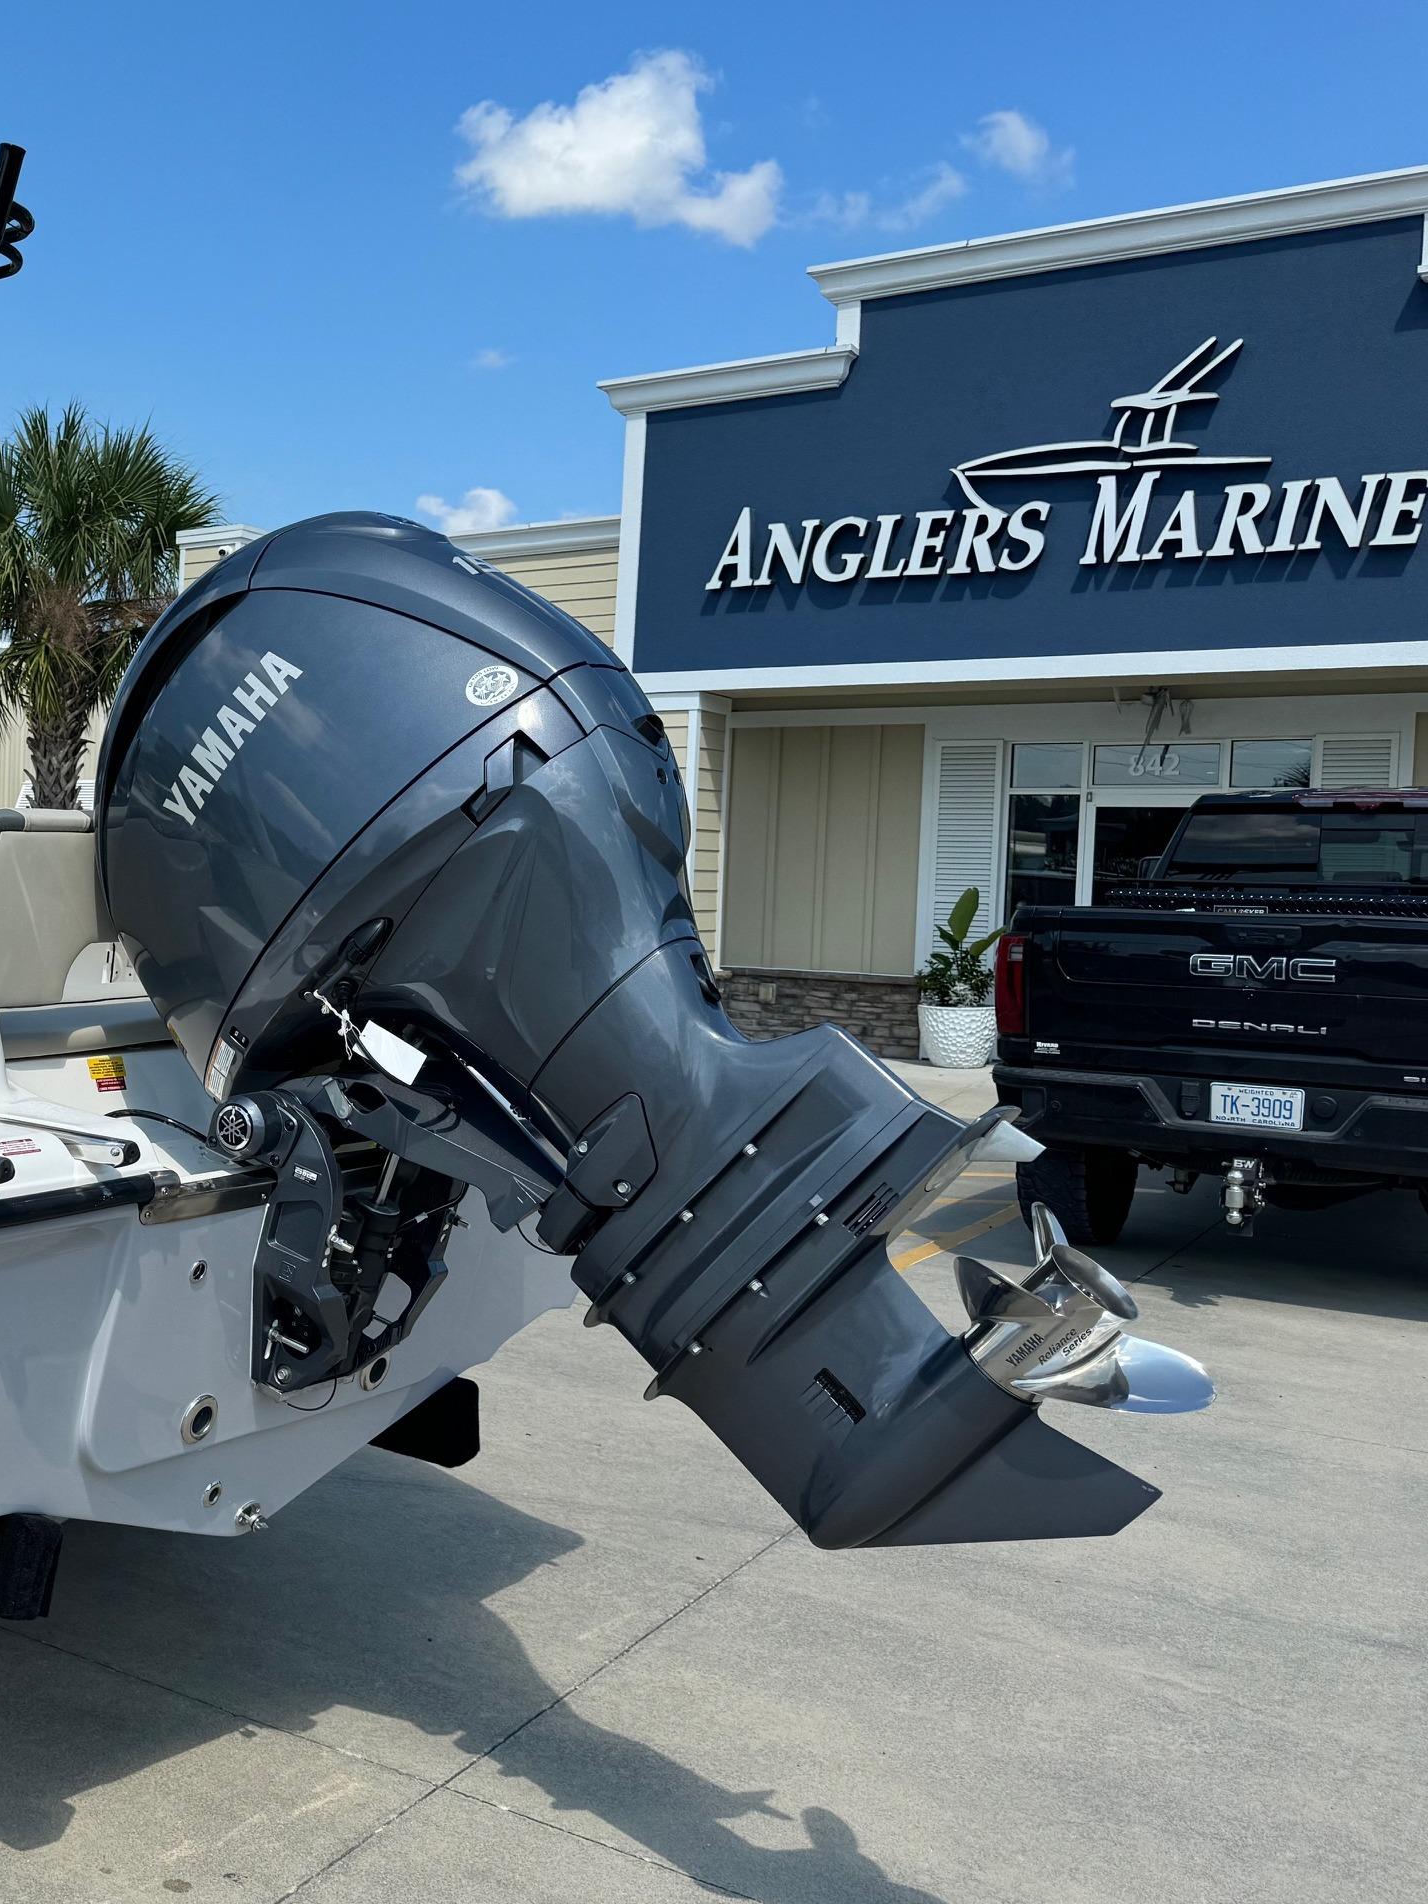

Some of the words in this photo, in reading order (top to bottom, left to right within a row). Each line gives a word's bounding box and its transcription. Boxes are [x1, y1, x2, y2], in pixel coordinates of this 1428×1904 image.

[705, 499, 1052, 590] ANGLERS
[1079, 471, 1428, 566] MARINE
[162, 650, 305, 826] YAMAHA
[1128, 753, 1181, 777] 842
[1189, 953, 1337, 983] GMC
[1192, 1018, 1327, 1035] DENALI
[1238, 1088, 1275, 1096] WEIGHTED
[1220, 1094, 1294, 1120] TK-3909
[1252, 1118, 1296, 1127] CAROLINA
[1005, 1333, 1045, 1367] YAMAHA
[1038, 1328, 1077, 1366] Reliance
[1062, 1328, 1093, 1357] Series
